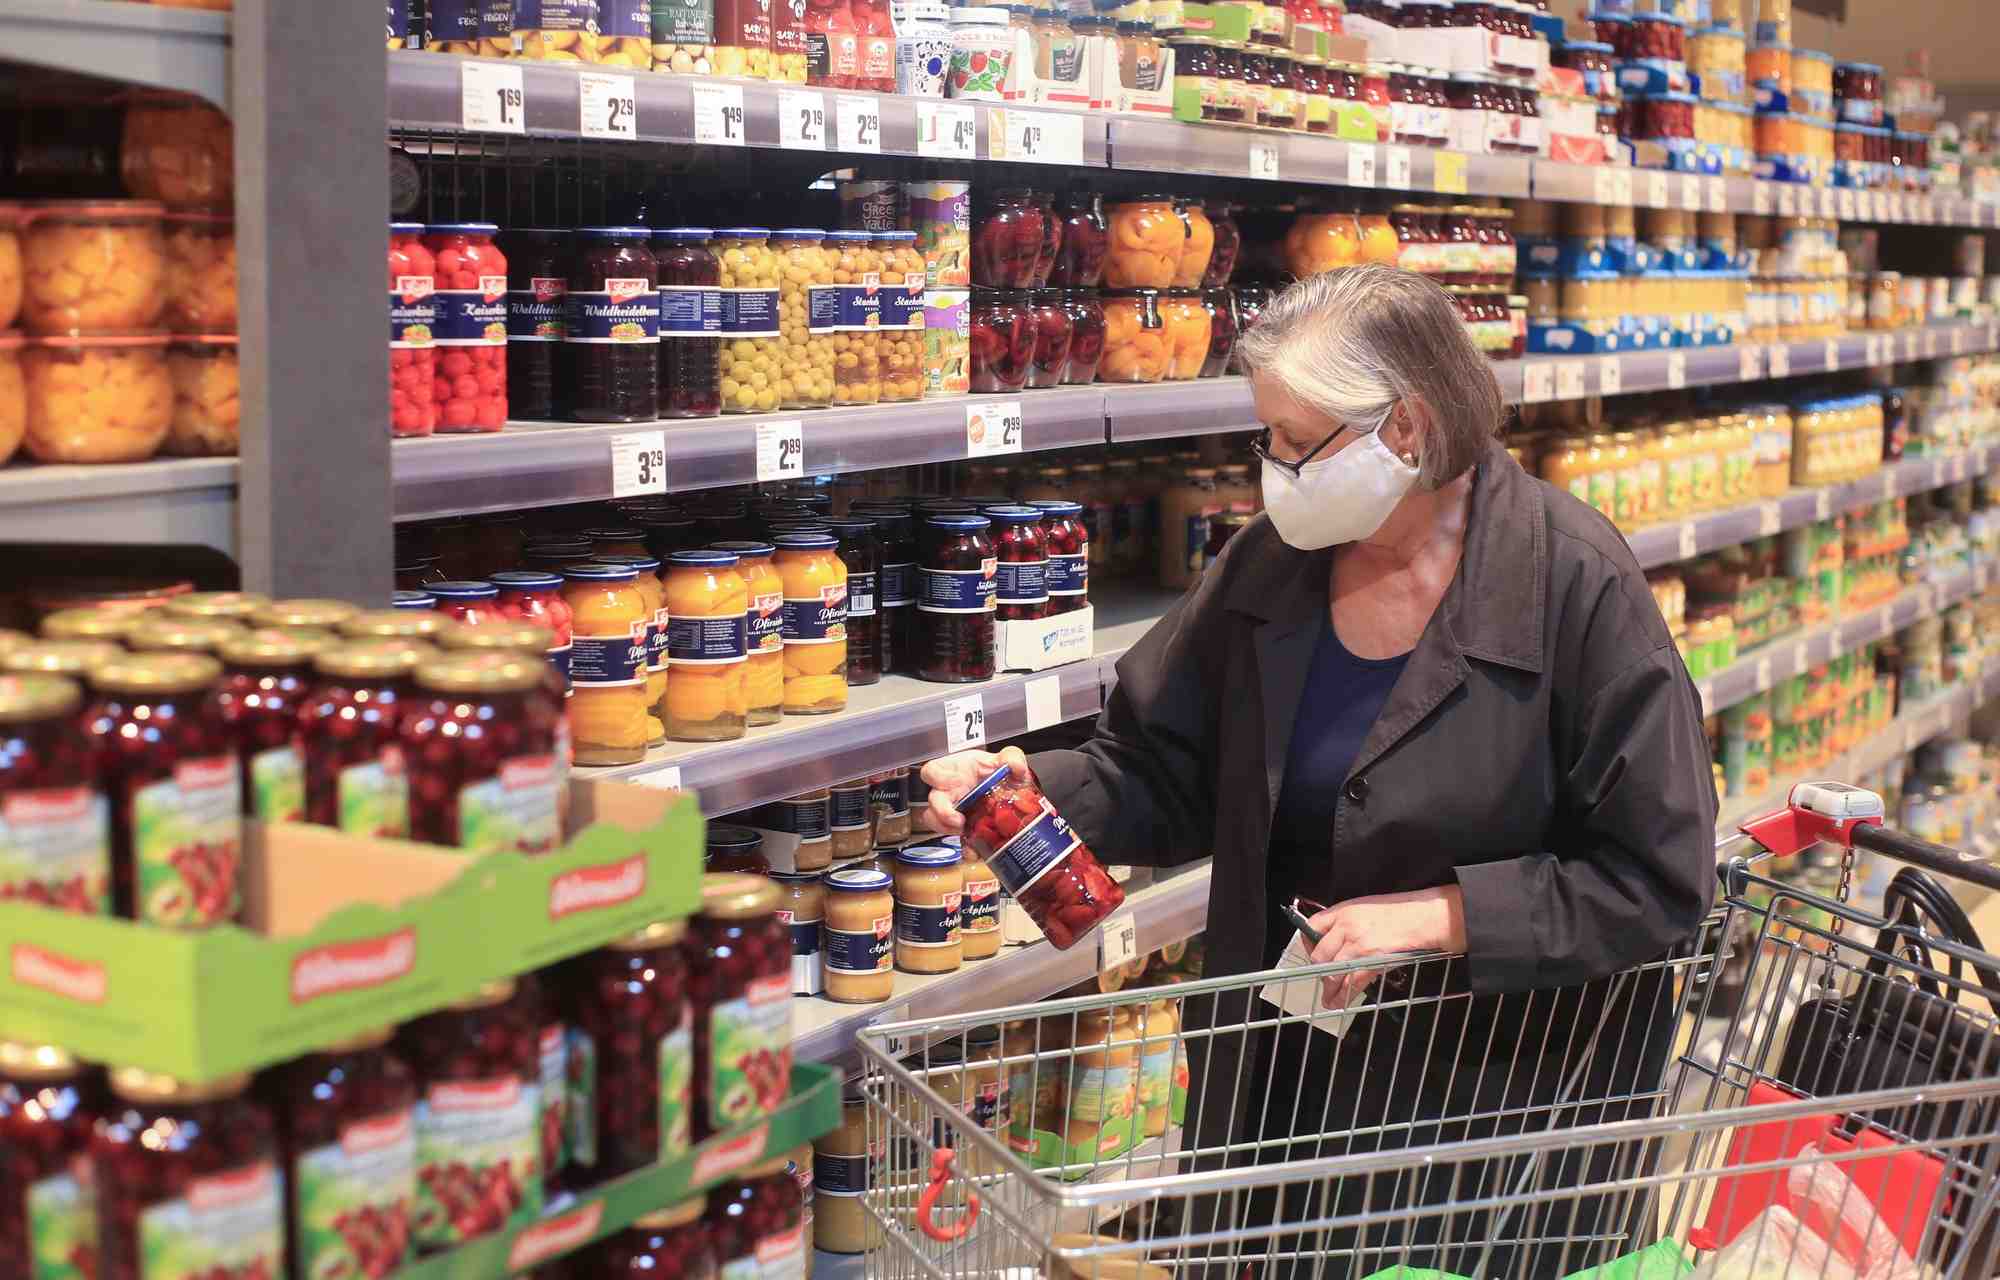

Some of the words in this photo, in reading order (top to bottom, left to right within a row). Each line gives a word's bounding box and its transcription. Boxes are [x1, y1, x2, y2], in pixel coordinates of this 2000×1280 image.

[496, 87, 522, 125] 1.69
[607, 97, 634, 132] 2.29
[721, 105, 743, 139] 1.49
[800, 108, 824, 141] 2.19
[856, 113, 878, 146] 2.29
[953, 120, 975, 151] 4.49
[1002, 416, 1021, 446] 2.99
[637, 450, 664, 485] 3.29
[778, 438, 802, 471] 2.89
[964, 708, 983, 741] 2.79
